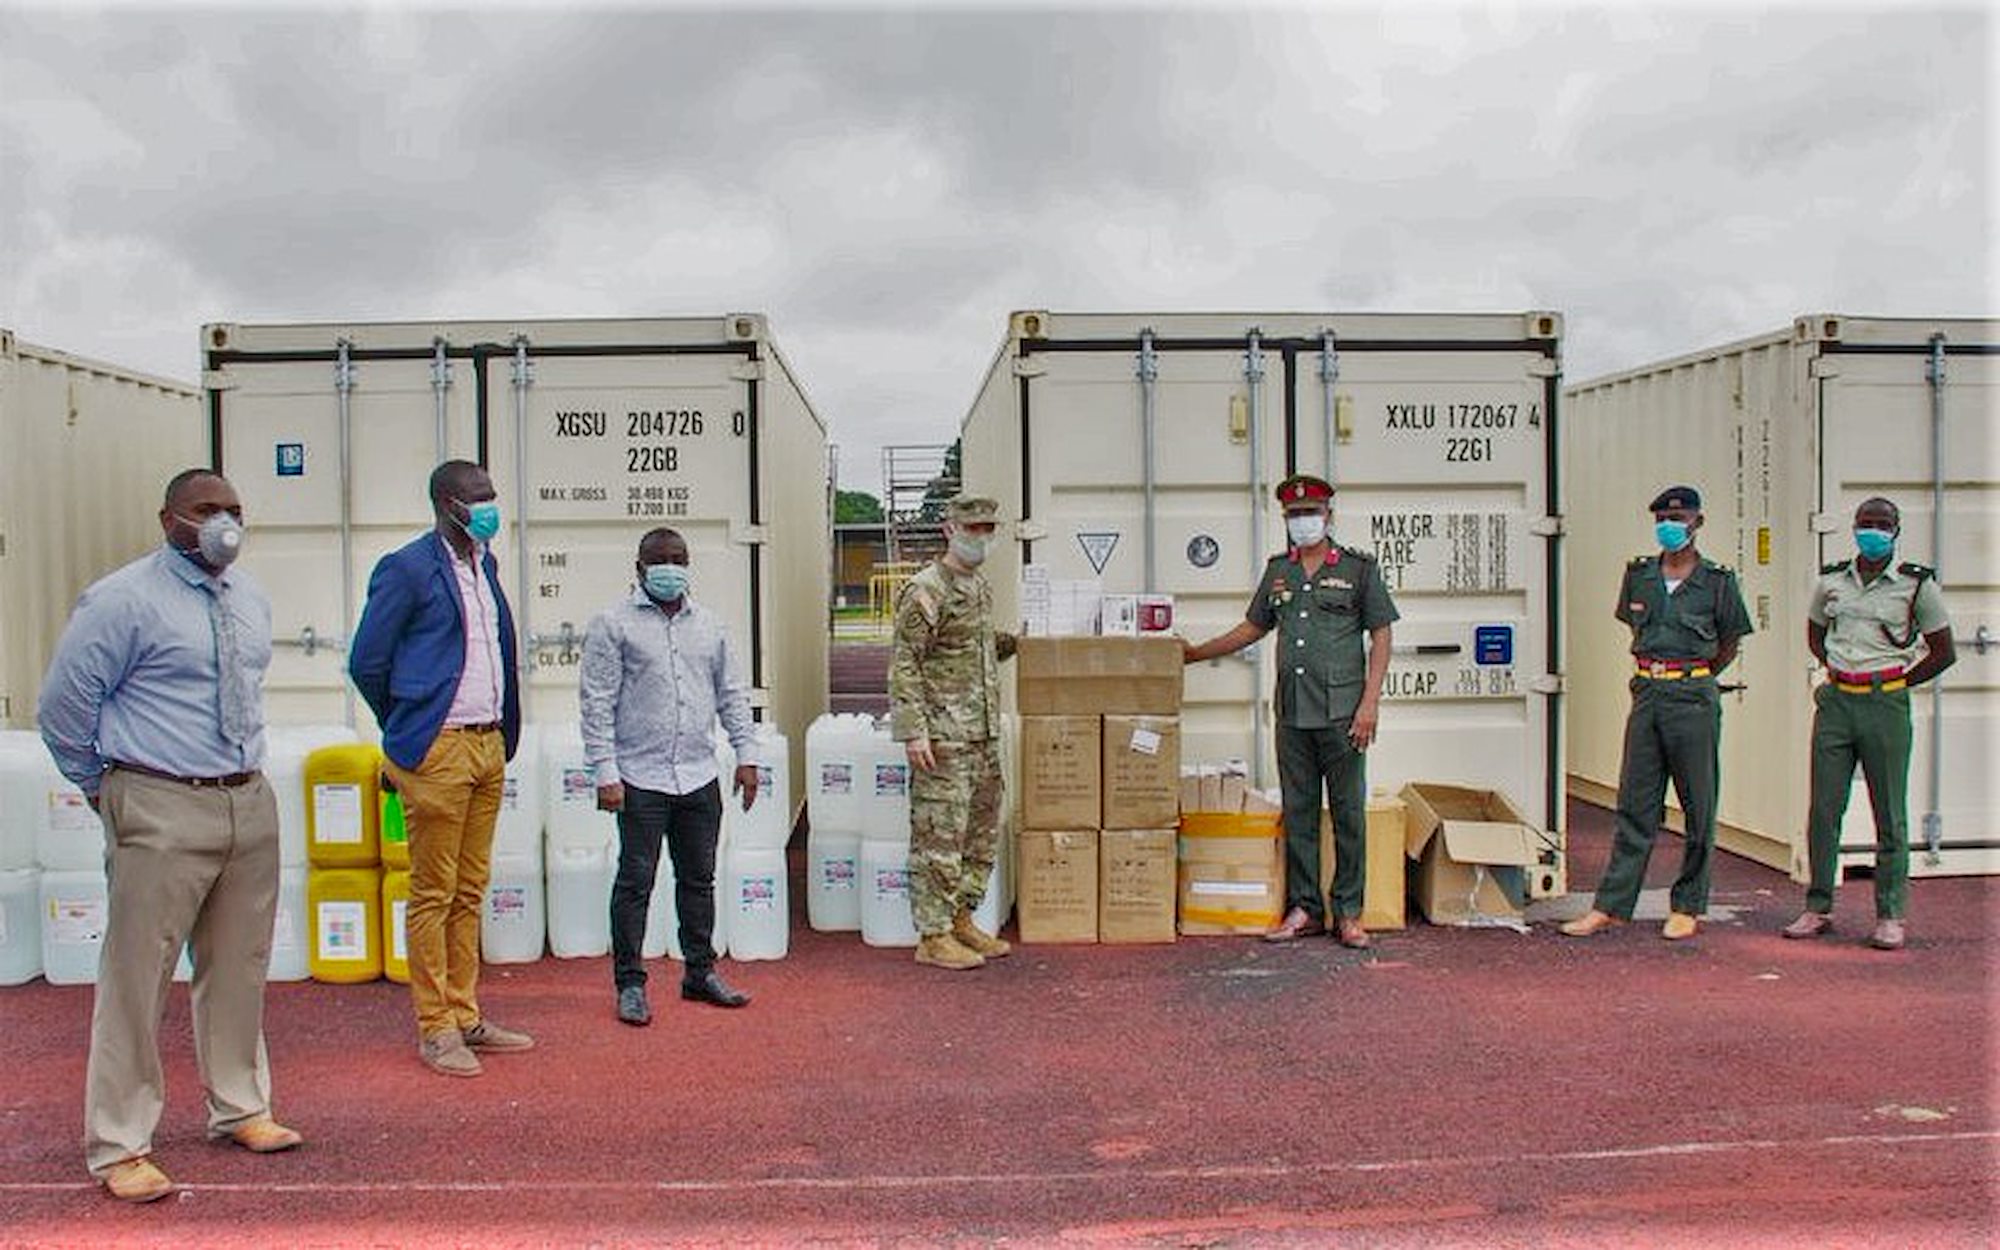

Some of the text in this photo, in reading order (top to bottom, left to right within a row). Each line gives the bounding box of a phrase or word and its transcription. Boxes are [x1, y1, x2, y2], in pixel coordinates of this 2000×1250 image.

[556, 411, 605, 436] XGSU
[627, 411, 703, 436] 204726
[1386, 404, 1540, 430] XXLU 172067 4
[627, 447, 678, 472] 22GB
[1447, 438, 1492, 462] 22G1
[1371, 540, 1416, 564] TARE
[1381, 564, 1405, 589] ET
[1380, 672, 1438, 696] U.CAP.
